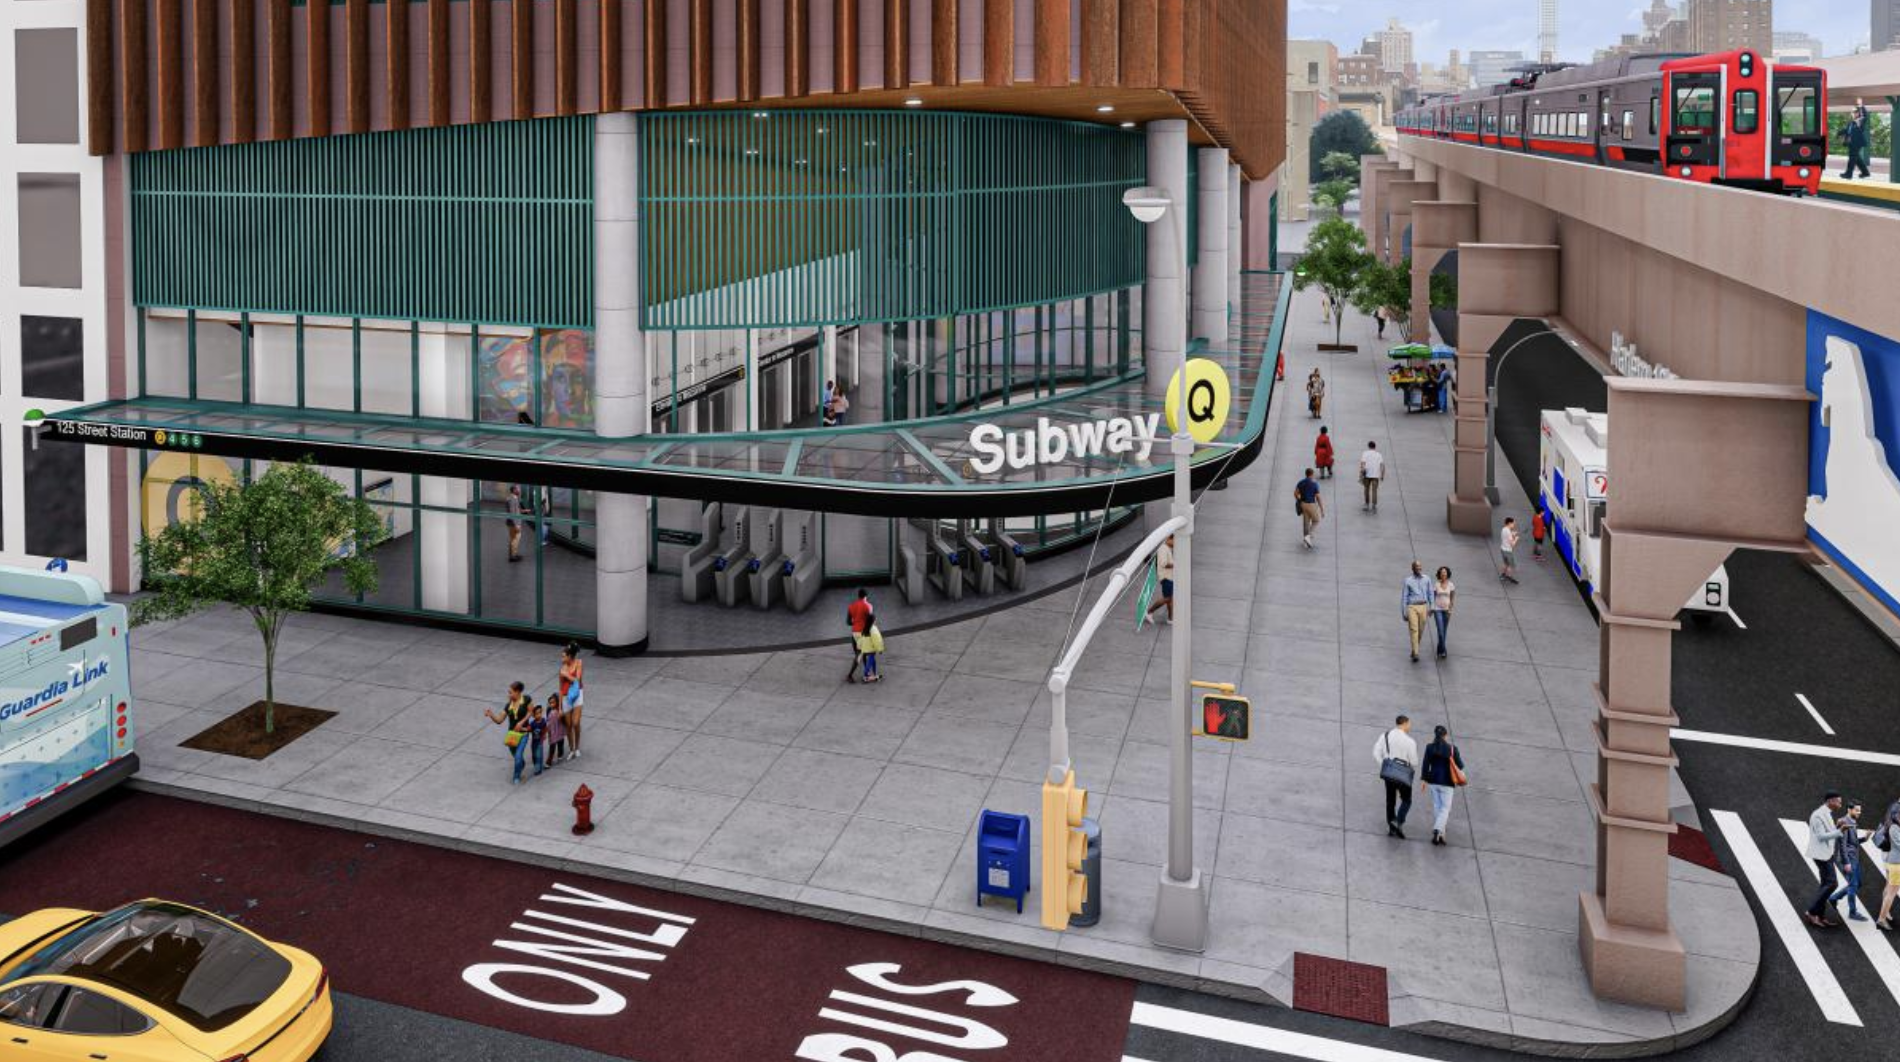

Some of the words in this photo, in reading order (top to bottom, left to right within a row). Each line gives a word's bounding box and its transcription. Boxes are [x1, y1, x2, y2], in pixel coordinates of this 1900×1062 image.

[57, 420, 75, 435] 125
[78, 423, 108, 438] Street
[110, 426, 147, 441] Station
[1187, 378, 1216, 424] Q
[968, 412, 1161, 474] Subway
[0, 681, 68, 720] Guardia
[72, 660, 108, 688] Link
[461, 882, 698, 1016] ONLY
[794, 962, 1020, 1062] BUS
